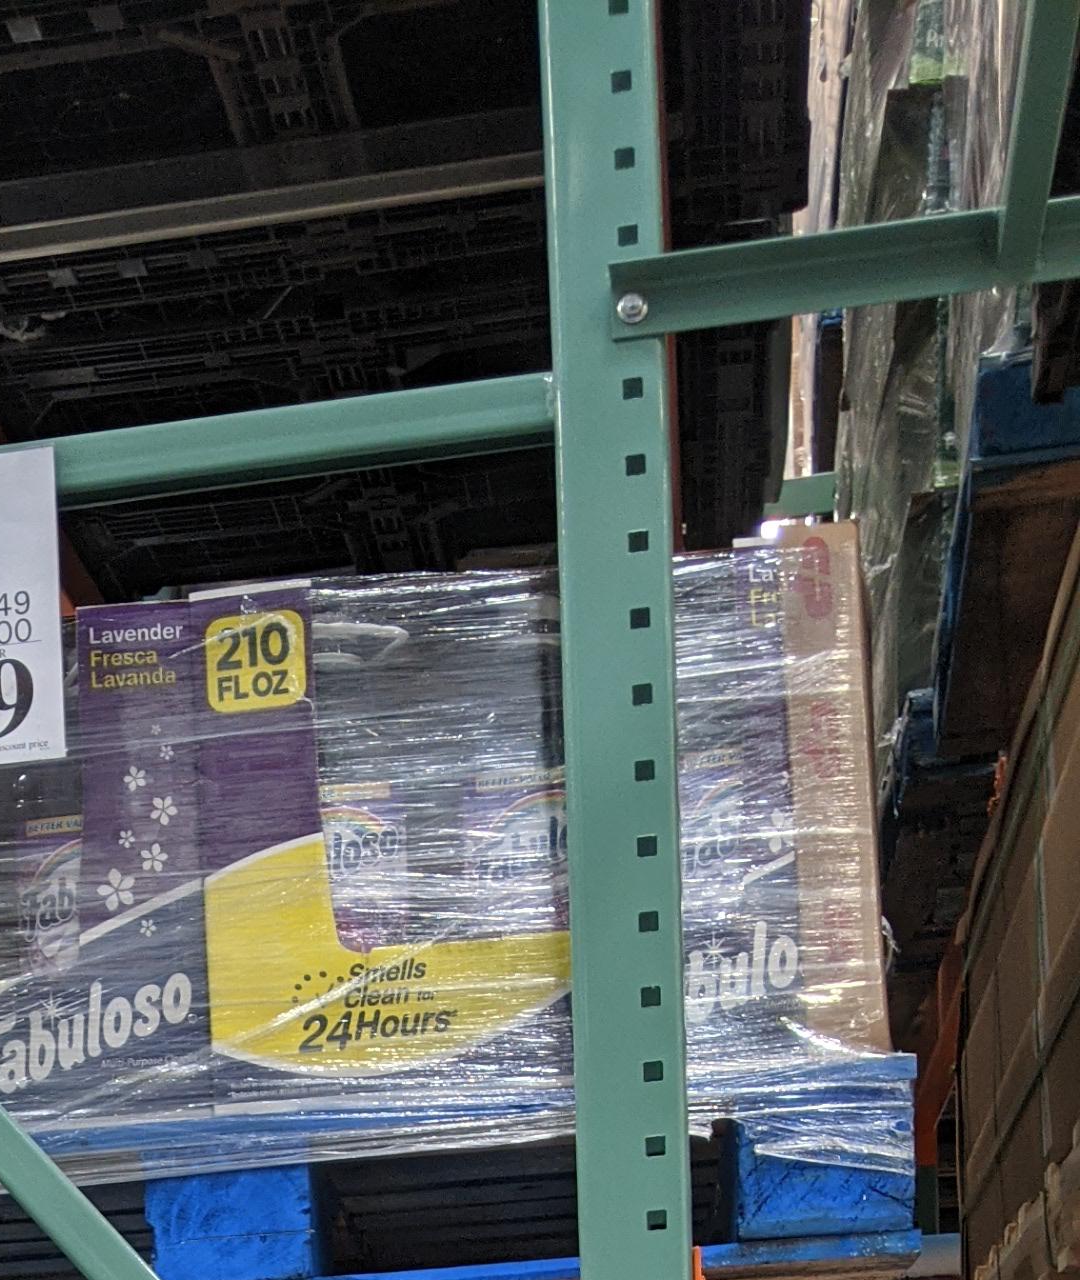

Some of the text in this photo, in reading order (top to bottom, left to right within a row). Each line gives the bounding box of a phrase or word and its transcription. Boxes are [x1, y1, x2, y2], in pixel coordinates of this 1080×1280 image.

[89, 623, 183, 645] Lavender
[216, 622, 290, 671] 210
[91, 650, 157, 668] Fresca
[91, 668, 176, 688] Lavanda
[217, 669, 289, 701] FL OZ
[29, 739, 49, 752] price
[348, 958, 427, 982] Smells
[343, 984, 410, 1009] Clean
